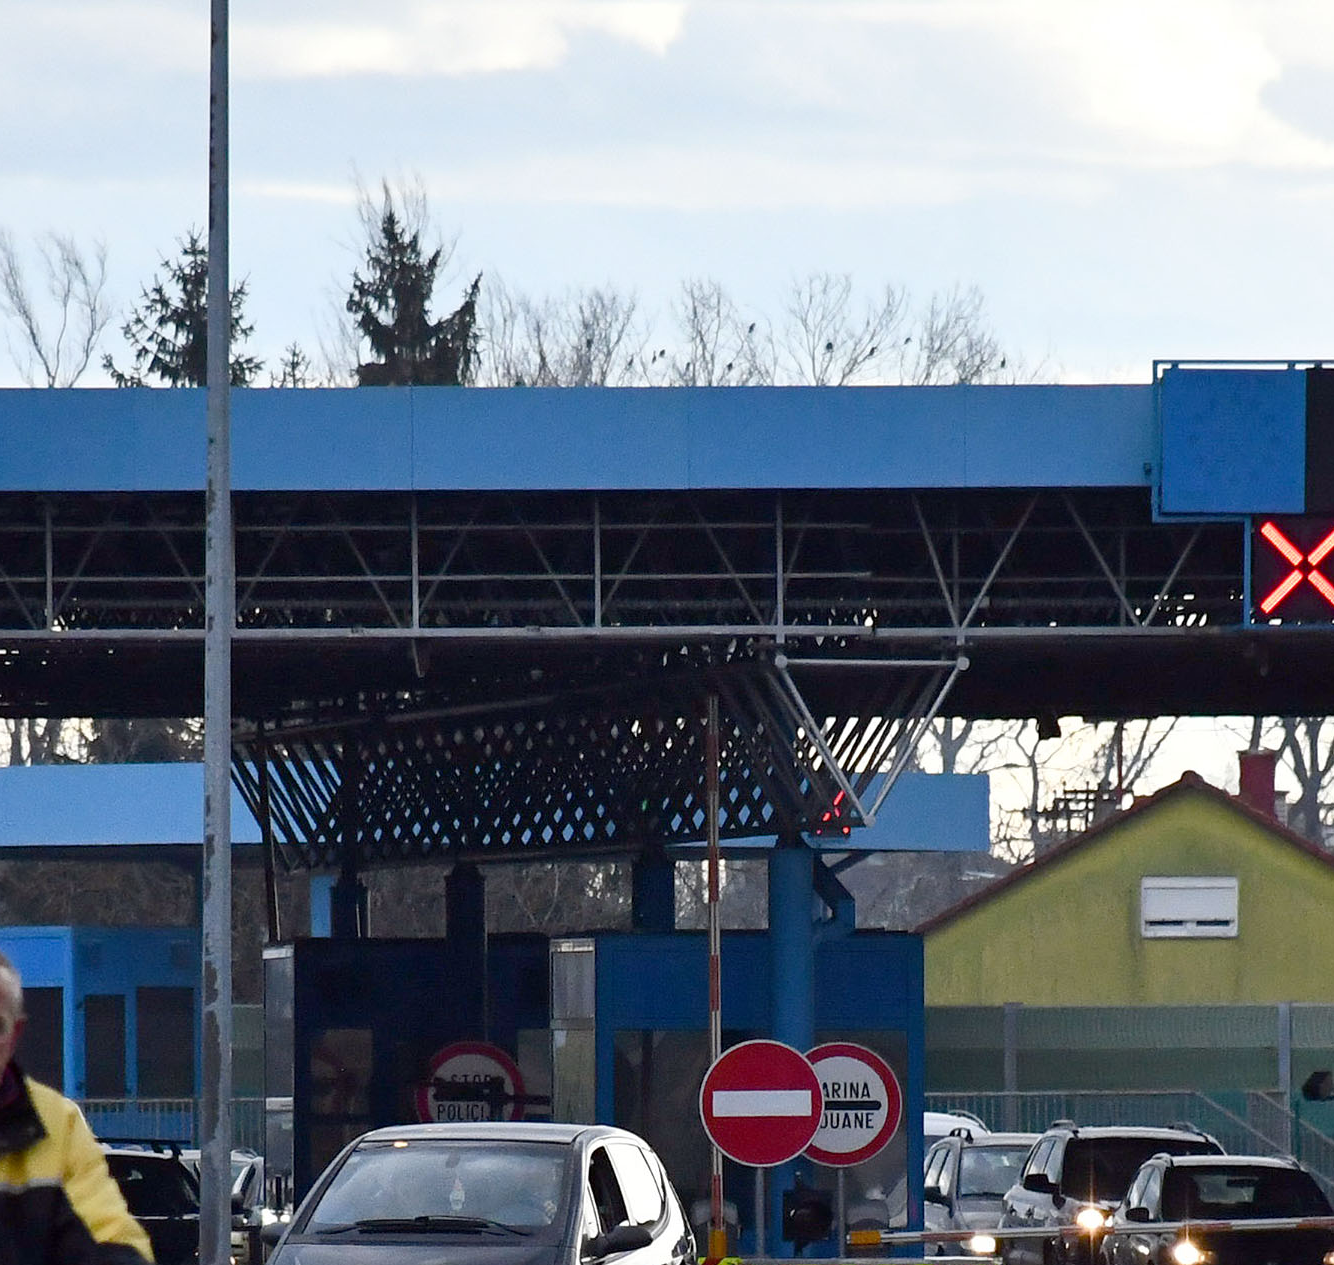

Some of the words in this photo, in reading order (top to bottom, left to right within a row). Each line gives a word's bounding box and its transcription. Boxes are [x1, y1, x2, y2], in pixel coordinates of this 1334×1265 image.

[822, 1082, 871, 1098] ARINA
[437, 1104, 490, 1121] POLICI
[819, 1112, 875, 1129] OUANE
